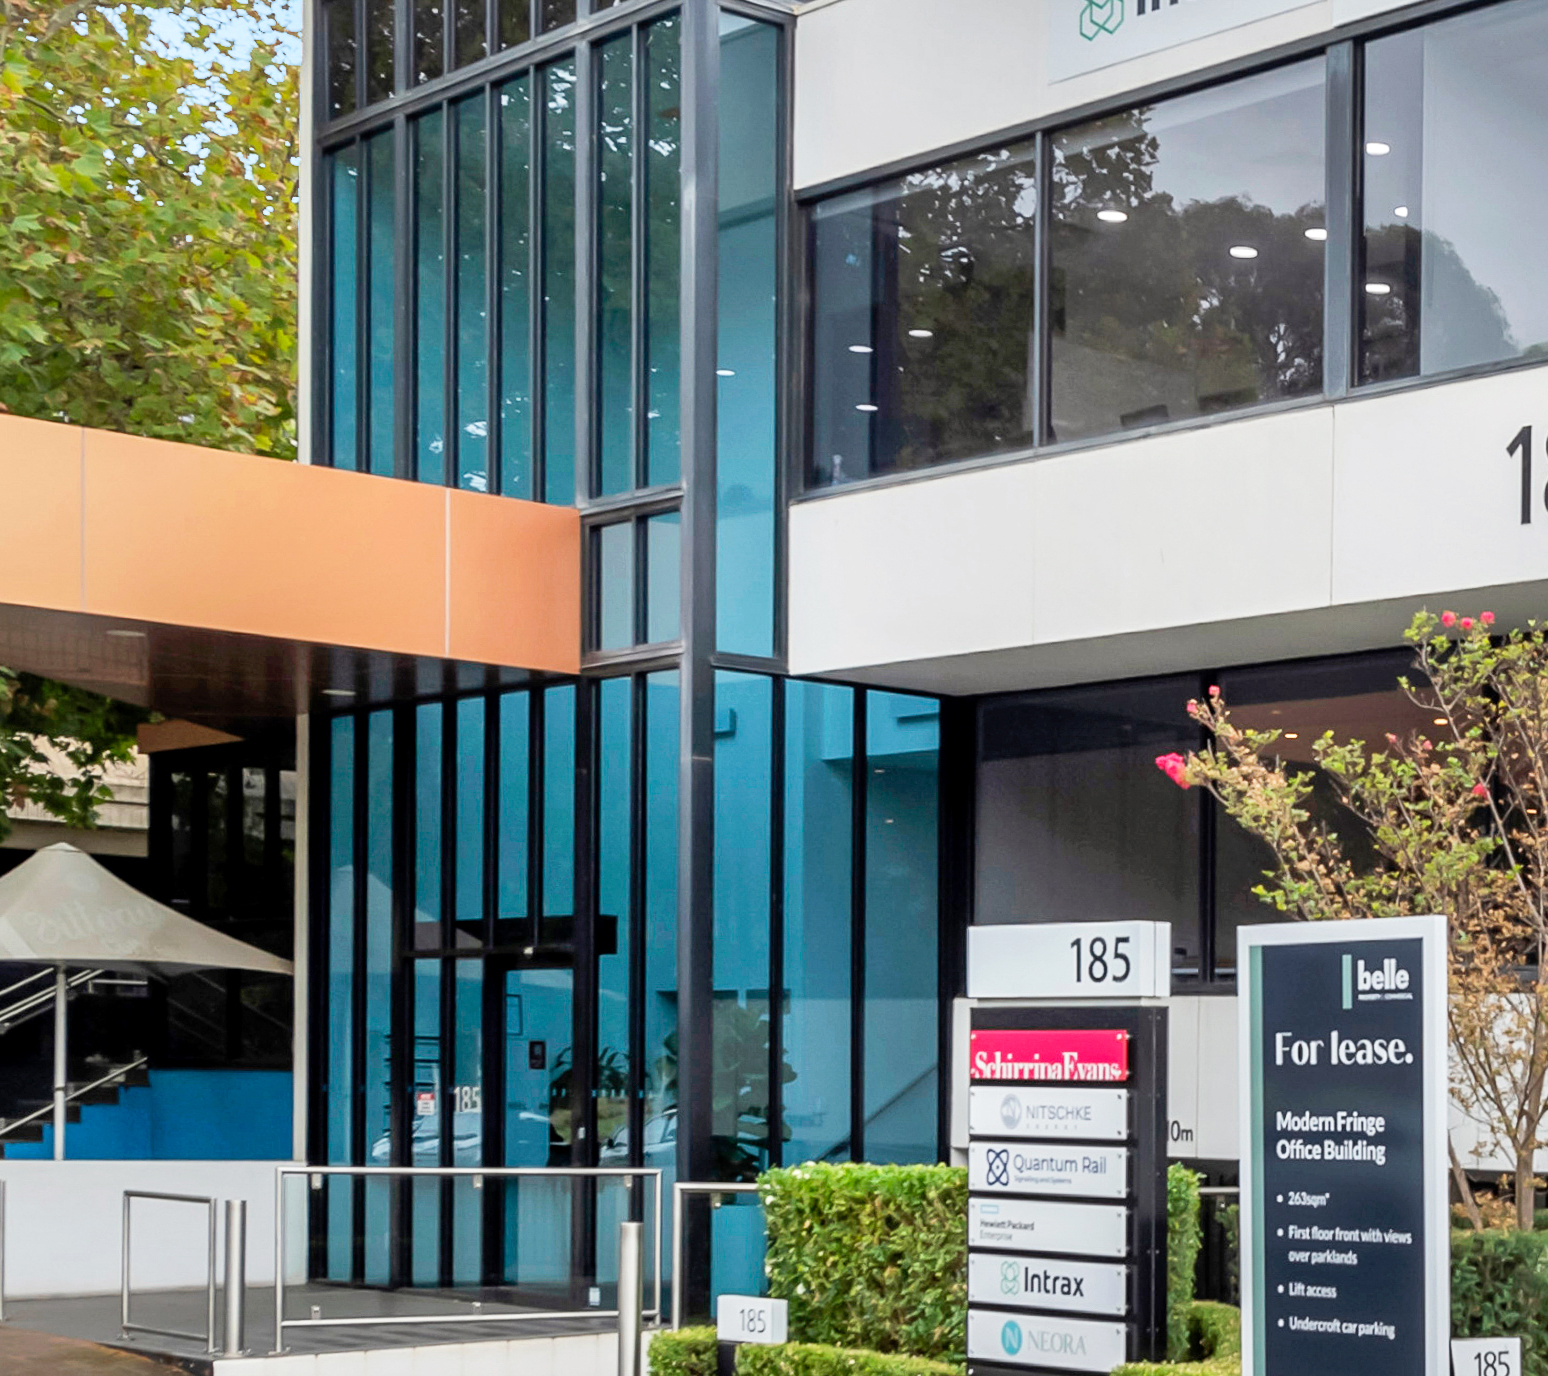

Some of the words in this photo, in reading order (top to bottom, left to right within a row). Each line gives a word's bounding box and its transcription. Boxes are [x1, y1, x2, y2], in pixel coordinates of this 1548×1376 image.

[1070, 936, 1131, 984] 185
[1357, 957, 1410, 992] belle
[1275, 1031, 1325, 1066] For
[1330, 1029, 1414, 1066] lease.
[453, 1086, 482, 1113] 185
[1025, 1105, 1092, 1121] NITSCHKE
[1276, 1110, 1335, 1132] Modern
[1336, 1110, 1386, 1137] Fringe
[1168, 1120, 1194, 1142] 0m
[1013, 1154, 1078, 1173] Quantum
[1082, 1156, 1107, 1174] Rail
[1276, 1138, 1322, 1160] Office
[1323, 1139, 1386, 1166] Building
[1008, 1220, 1035, 1231] Packard
[1288, 1224, 1311, 1240] First
[1311, 1225, 1334, 1241] floor
[1335, 1226, 1360, 1242] front
[1360, 1228, 1383, 1243] with
[1383, 1228, 1413, 1244] views
[1288, 1250, 1311, 1263] over
[1311, 1249, 1358, 1265] parklands
[1024, 1266, 1085, 1297] Intrax
[1288, 1282, 1305, 1297] Lift
[1306, 1285, 1337, 1299] access
[739, 1308, 767, 1333] 185
[1288, 1315, 1341, 1334] Undercroft
[1341, 1322, 1358, 1334] car
[1358, 1321, 1396, 1340] parking
[1027, 1330, 1087, 1356] NEORA
